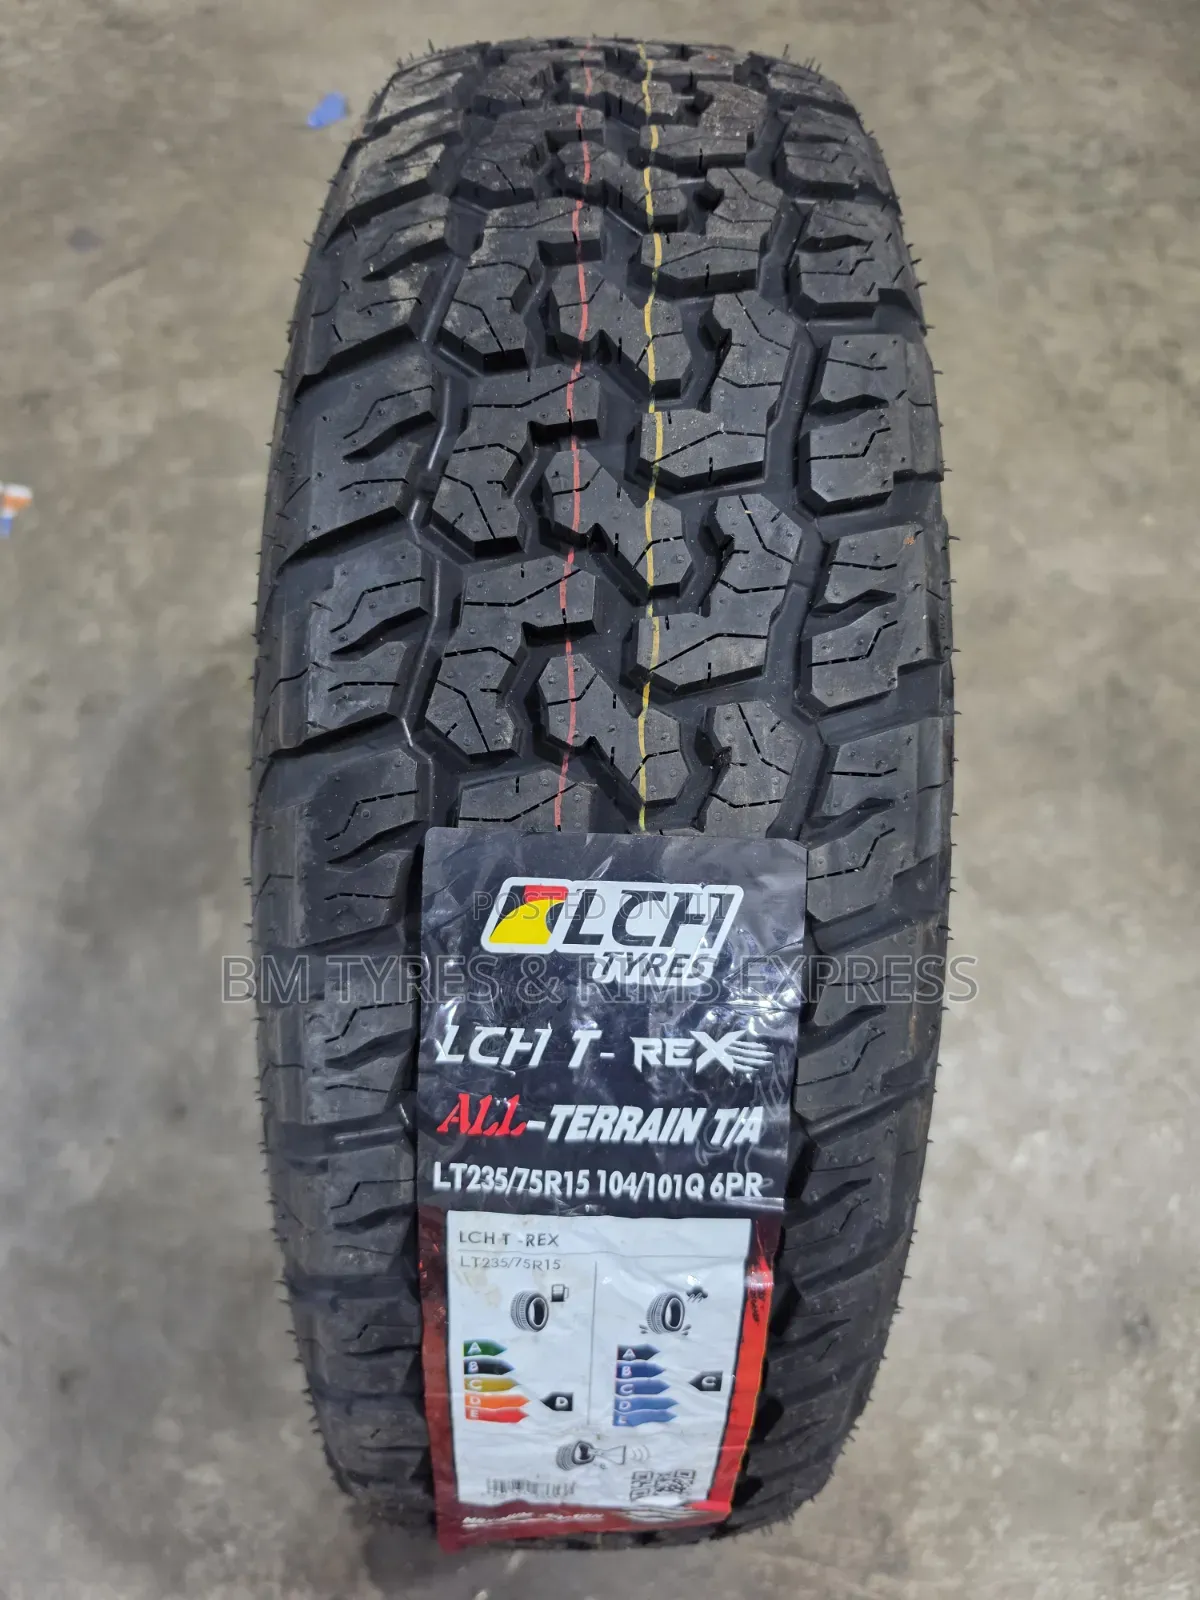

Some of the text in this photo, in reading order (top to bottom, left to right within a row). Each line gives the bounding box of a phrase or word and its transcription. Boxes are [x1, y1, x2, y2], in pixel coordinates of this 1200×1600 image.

[562, 887, 736, 948] LCH
[600, 950, 711, 980] TYRES
[434, 1024, 554, 1067] LCH
[630, 1029, 744, 1075] REX
[709, 1105, 765, 1151] T/A
[433, 1161, 764, 1202] LT235/75R15 104/101Q 6PR
[459, 1230, 495, 1245] LCH
[460, 1255, 562, 1271] LT235/75R15
[467, 1341, 482, 1355] A
[622, 1348, 637, 1360] A
[468, 1361, 479, 1374] B
[621, 1365, 632, 1377] B
[469, 1379, 483, 1391] C
[701, 1375, 717, 1388] C
[620, 1383, 635, 1395] C
[469, 1395, 482, 1406] D
[555, 1396, 569, 1410] D
[619, 1400, 632, 1411] D
[470, 1411, 480, 1419] E
